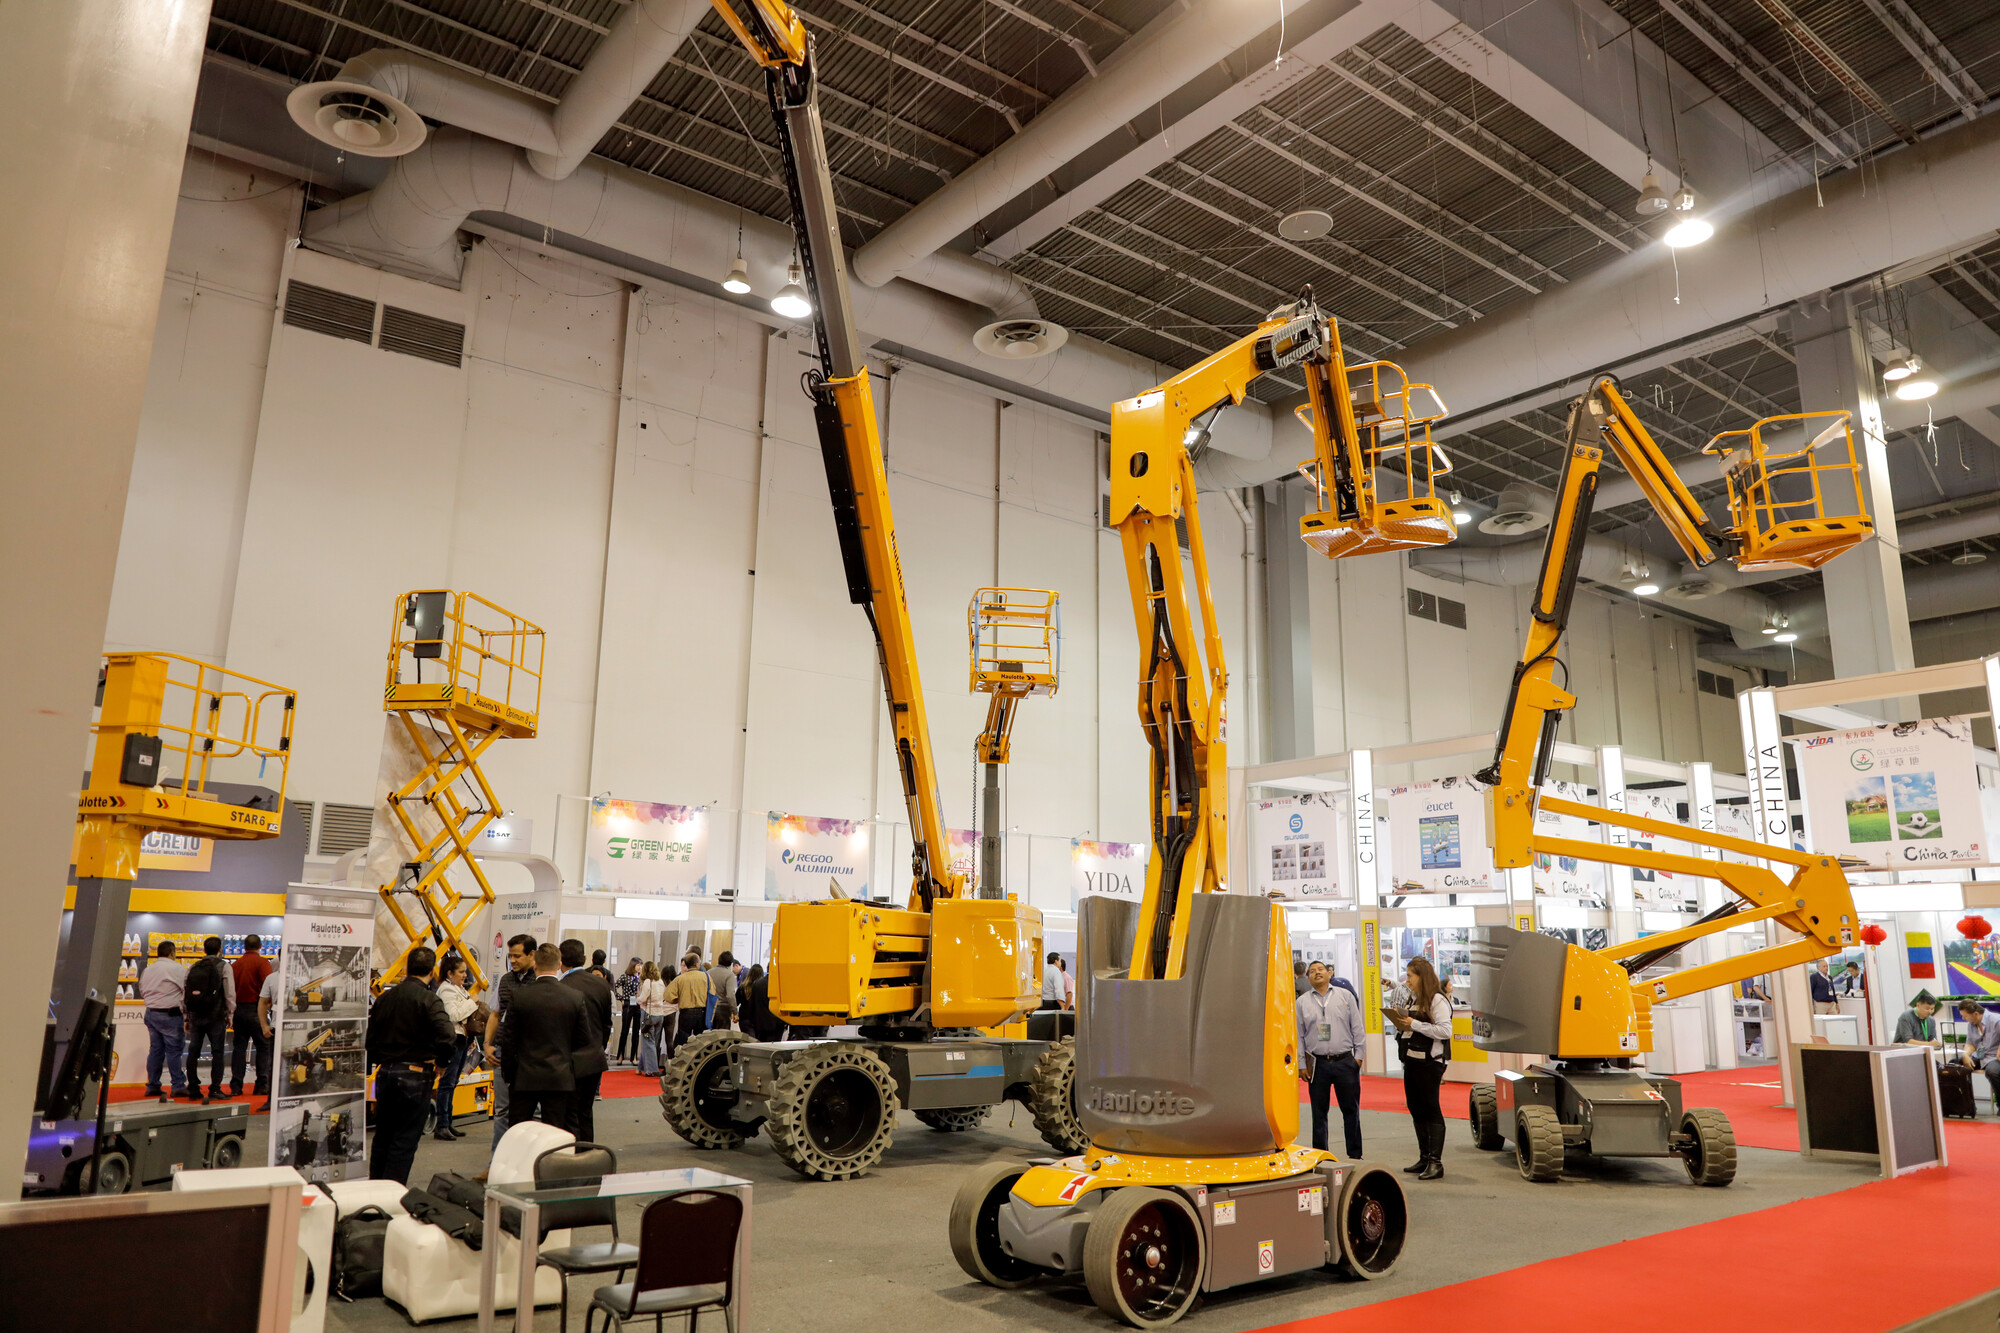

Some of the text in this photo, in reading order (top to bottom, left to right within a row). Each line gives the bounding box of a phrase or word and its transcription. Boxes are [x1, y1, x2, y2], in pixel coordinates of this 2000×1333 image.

[1761, 745, 1787, 835] CHINA
[1358, 793, 1374, 863] CHINA
[630, 839, 693, 854] GREEN HOME
[1904, 846, 1948, 861] China
[797, 853, 833, 864] REGOO
[794, 864, 854, 875] ALUMINIUM
[1084, 870, 1132, 893] YIDA
[311, 922, 341, 934] Haulotte
[1090, 1086, 1195, 1115] Haulotte
